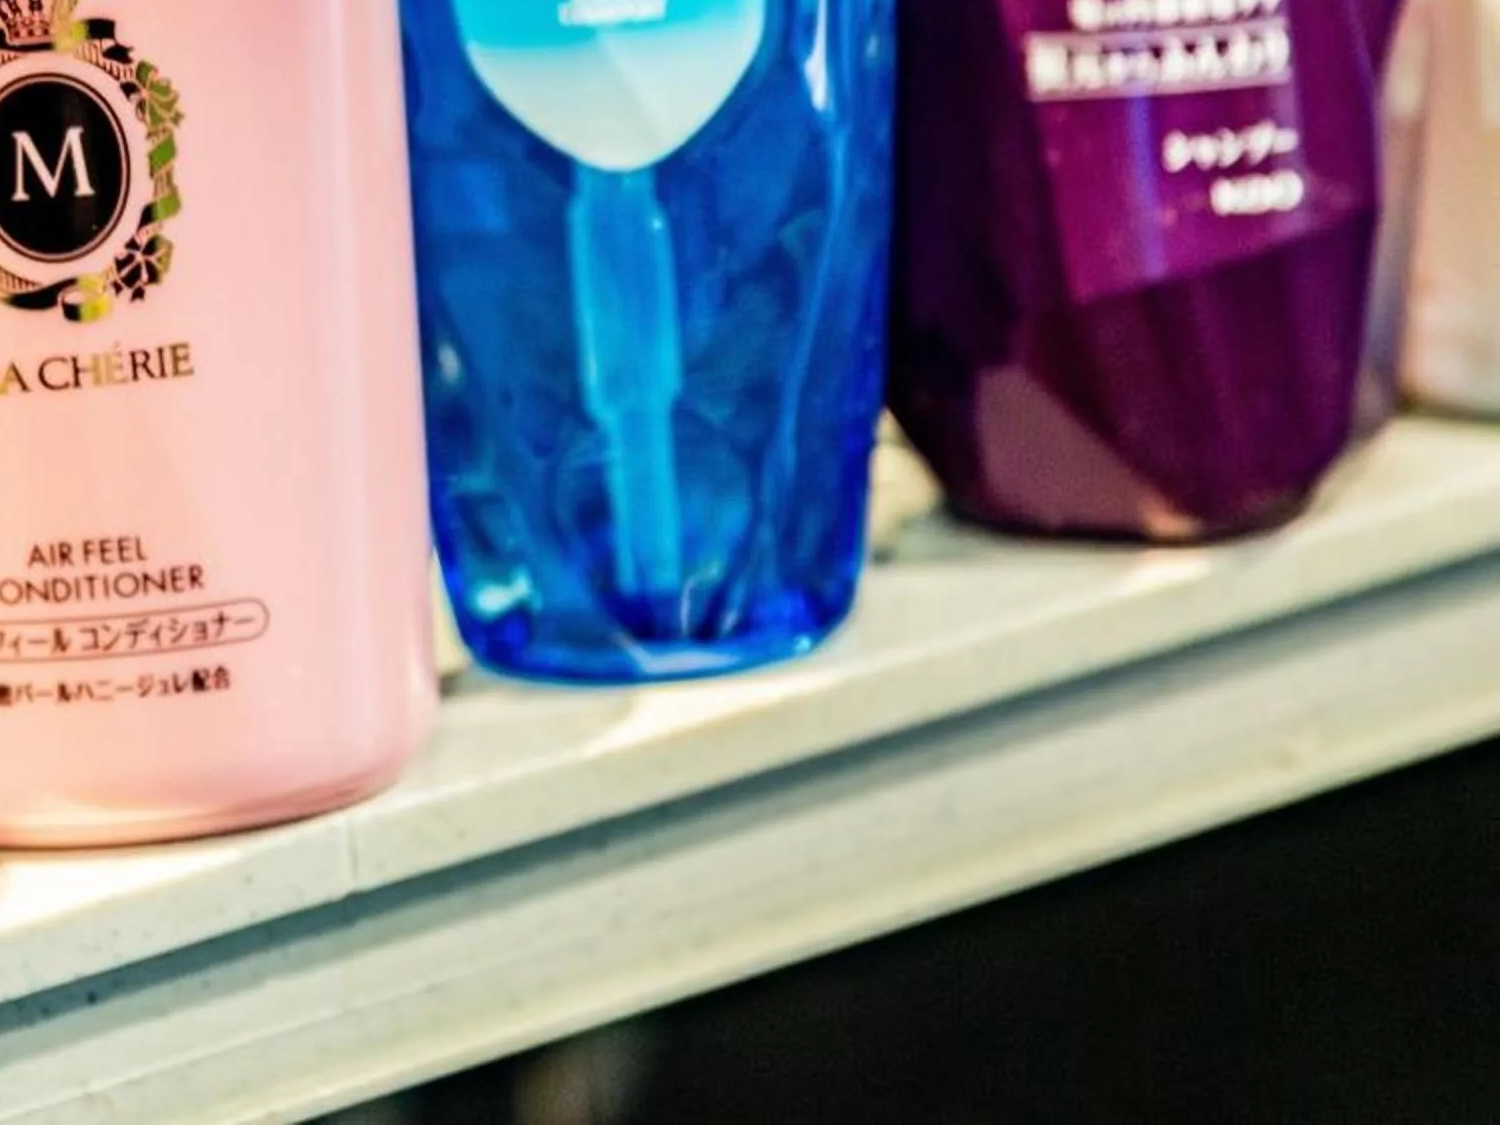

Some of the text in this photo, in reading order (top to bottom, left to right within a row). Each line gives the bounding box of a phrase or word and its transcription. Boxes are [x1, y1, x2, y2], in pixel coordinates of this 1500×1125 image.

[11, 126, 95, 202] M
[38, 341, 195, 391] CHÉRIE
[27, 536, 148, 568] AIR FEEL
